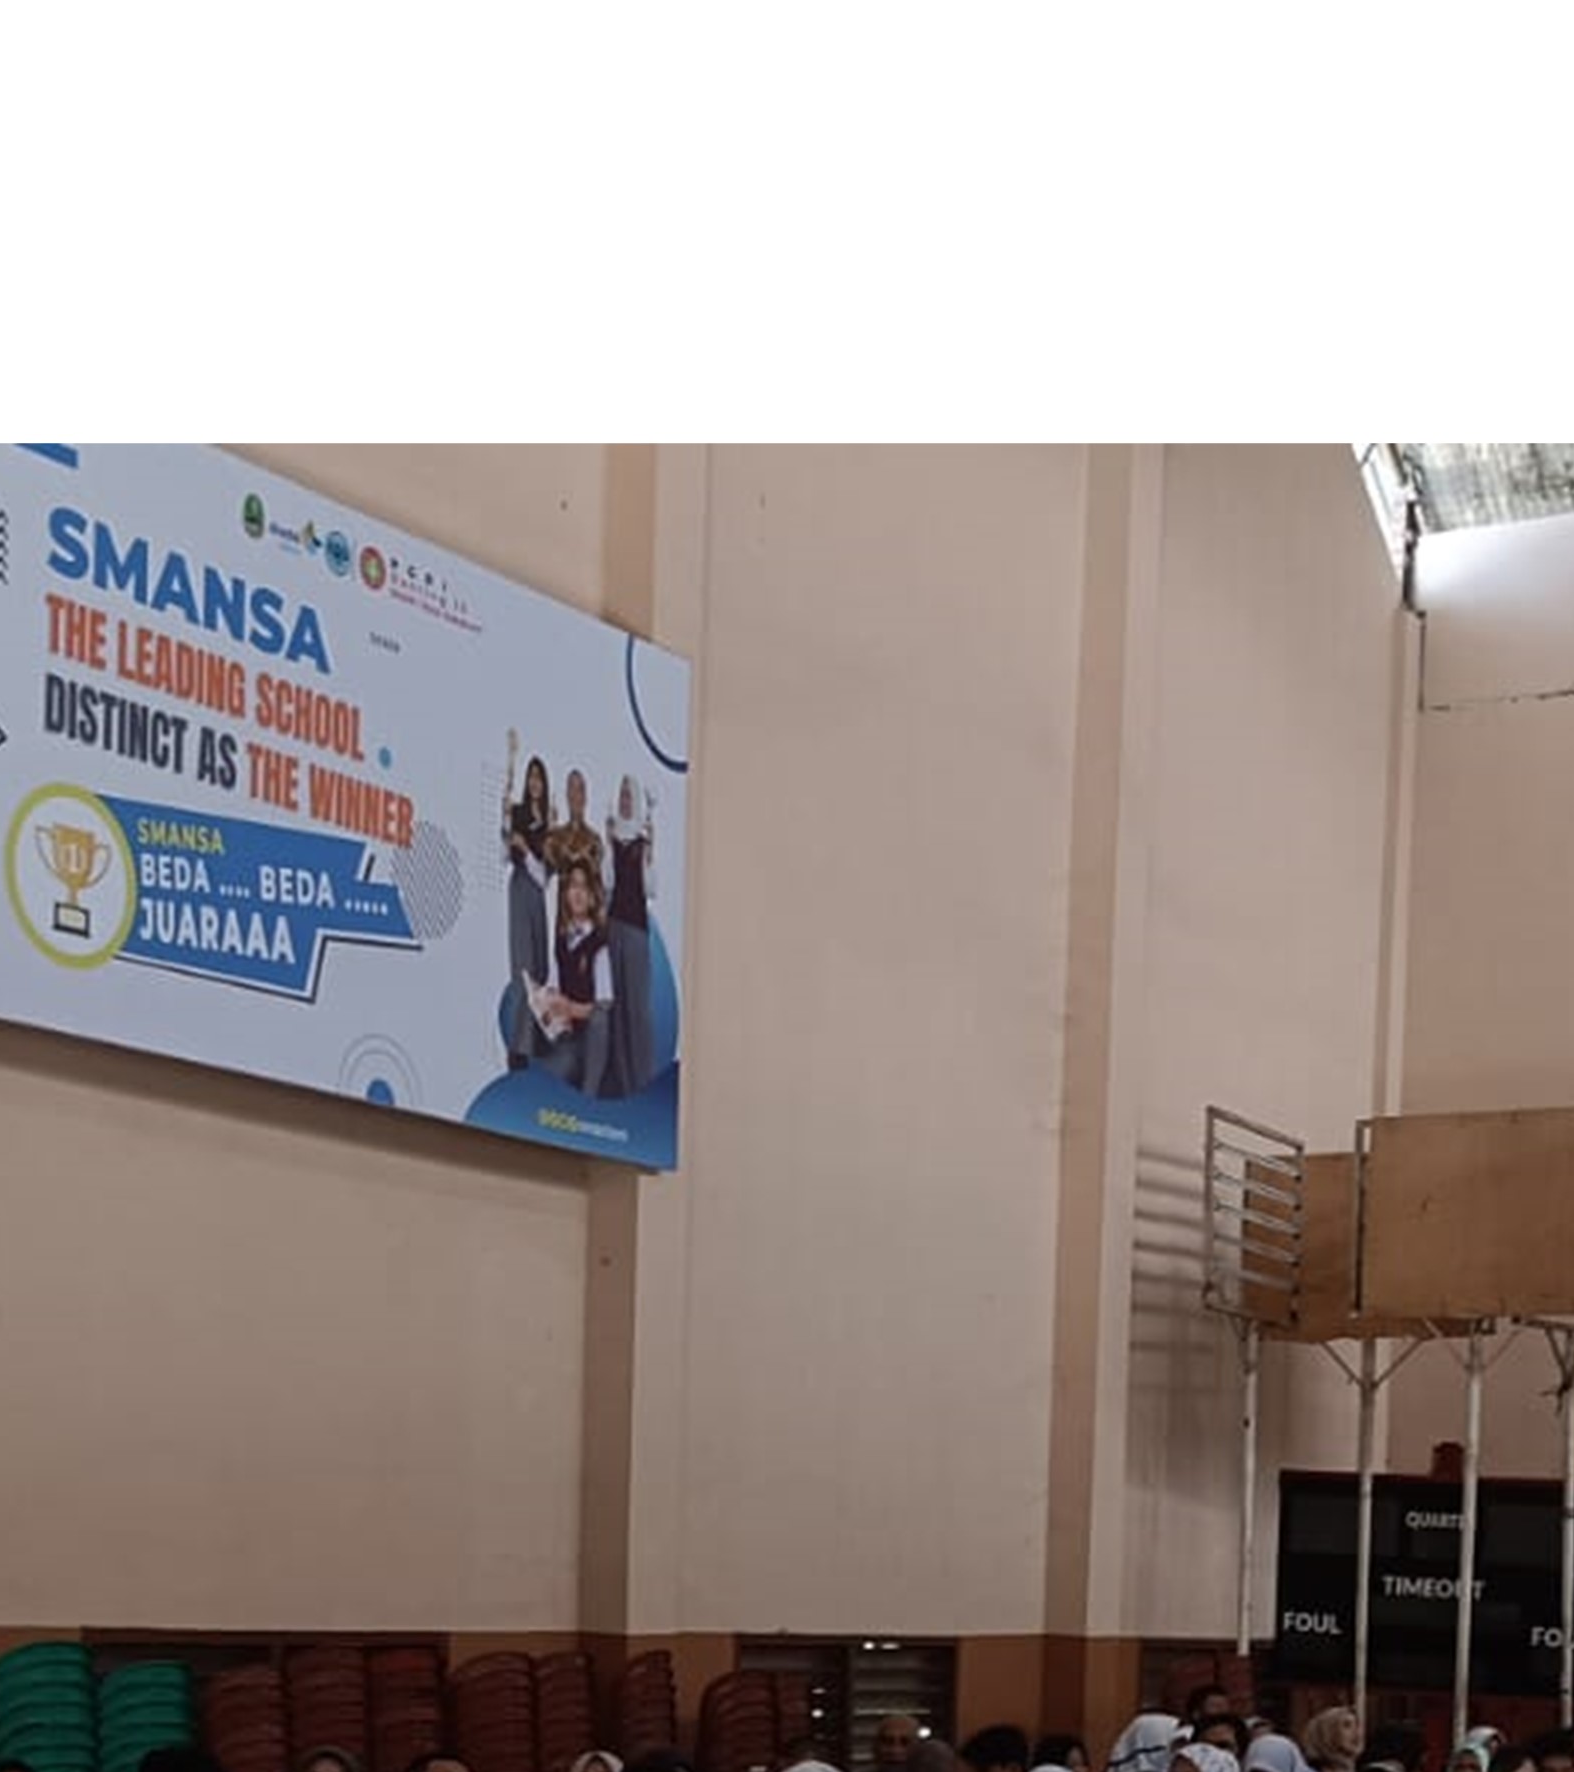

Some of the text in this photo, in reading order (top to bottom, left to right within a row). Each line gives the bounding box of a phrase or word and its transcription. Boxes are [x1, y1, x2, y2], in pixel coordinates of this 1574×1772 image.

[47, 506, 330, 674] SMANSA
[45, 593, 365, 763] THE LEADING SCHOOL
[43, 672, 414, 850] DISTINCT AS THE WINNER
[137, 817, 225, 856] SMANSA
[140, 853, 210, 894] BEDA
[259, 865, 336, 909] BEDA
[139, 898, 297, 965] JUARAAA
[1283, 1611, 1342, 1635] FOUL
